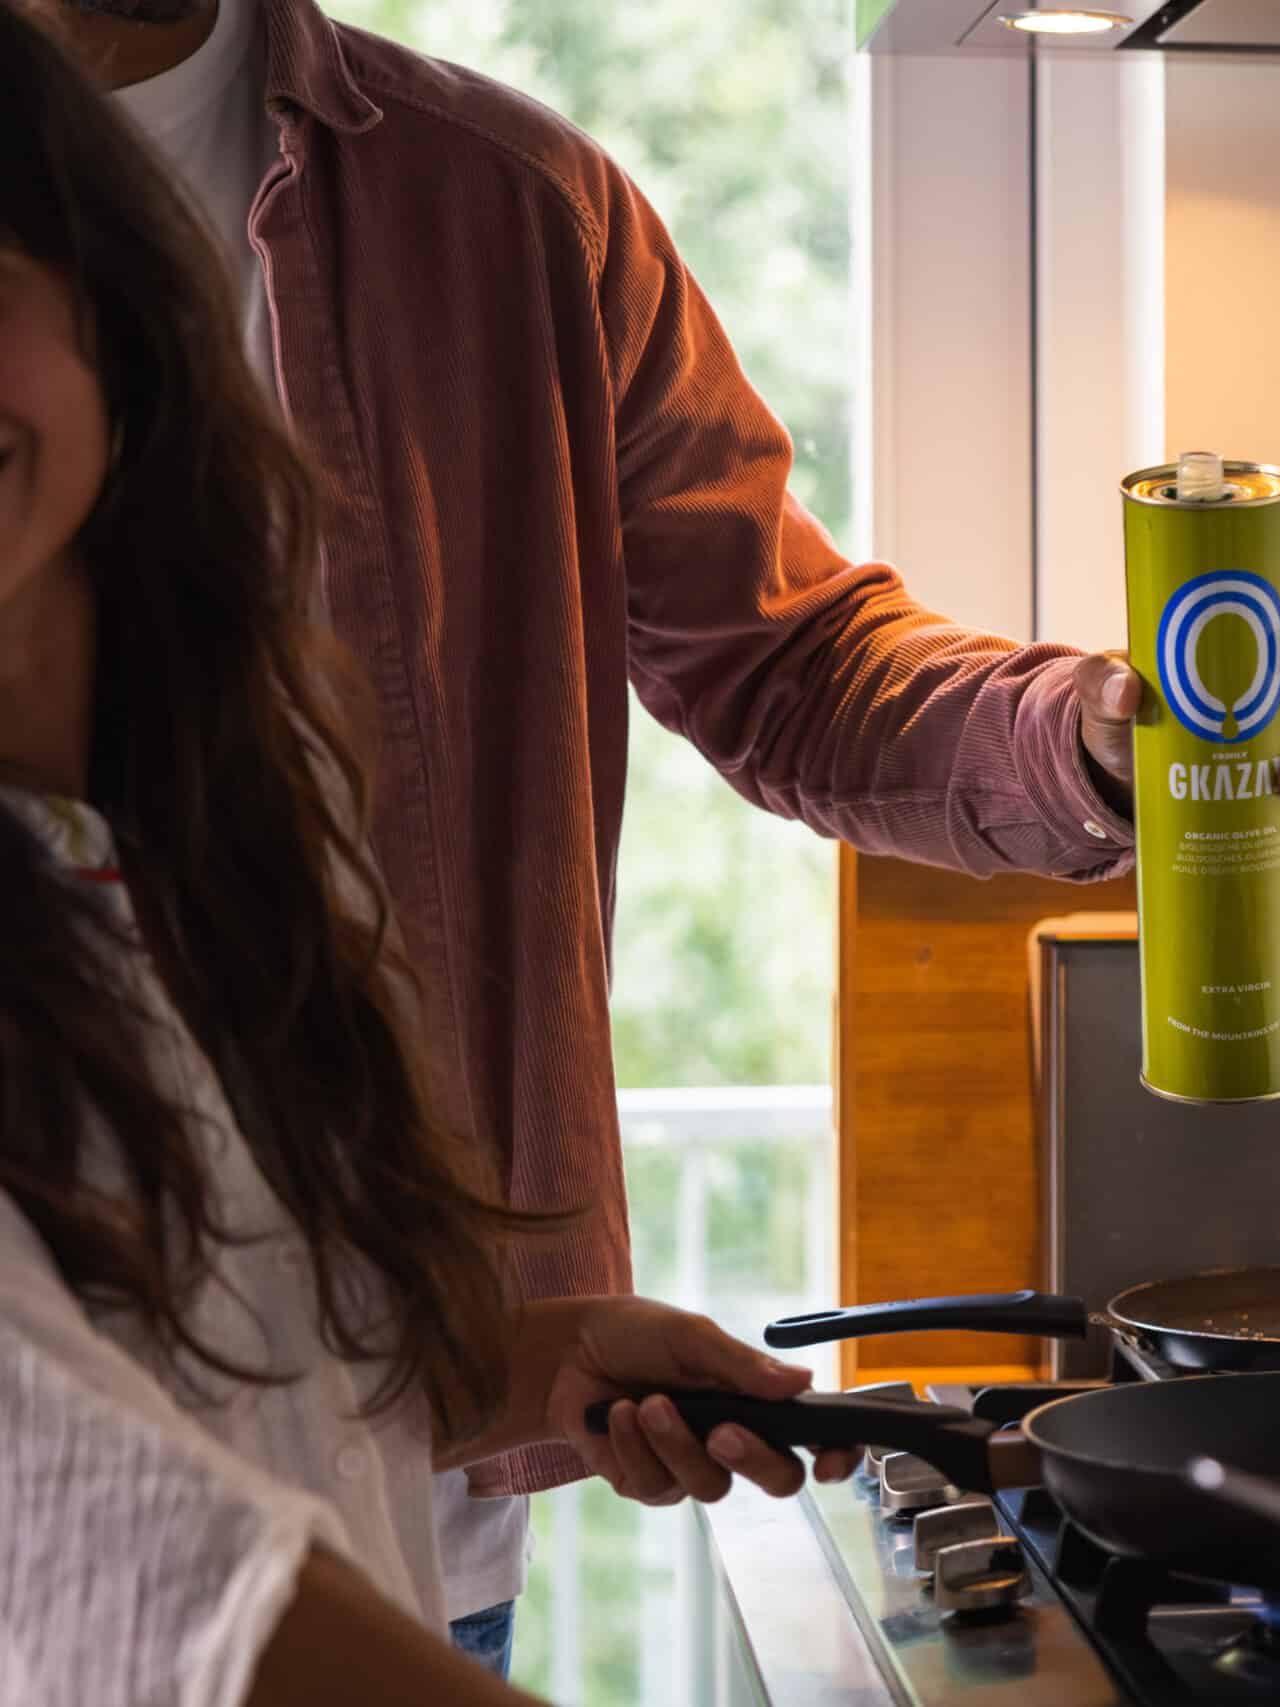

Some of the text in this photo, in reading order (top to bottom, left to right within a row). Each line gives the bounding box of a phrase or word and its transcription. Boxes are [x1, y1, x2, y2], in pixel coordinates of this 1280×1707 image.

[1184, 831, 1230, 840] ORGANIC
[1231, 828, 1260, 840] OLIVE
[1200, 981, 1271, 994] EXTRA VIRGIN
[1167, 1015, 1190, 1033] FROM
[1192, 1028, 1209, 1039] THE
[1211, 1026, 1268, 1041] MOUNTAINS
